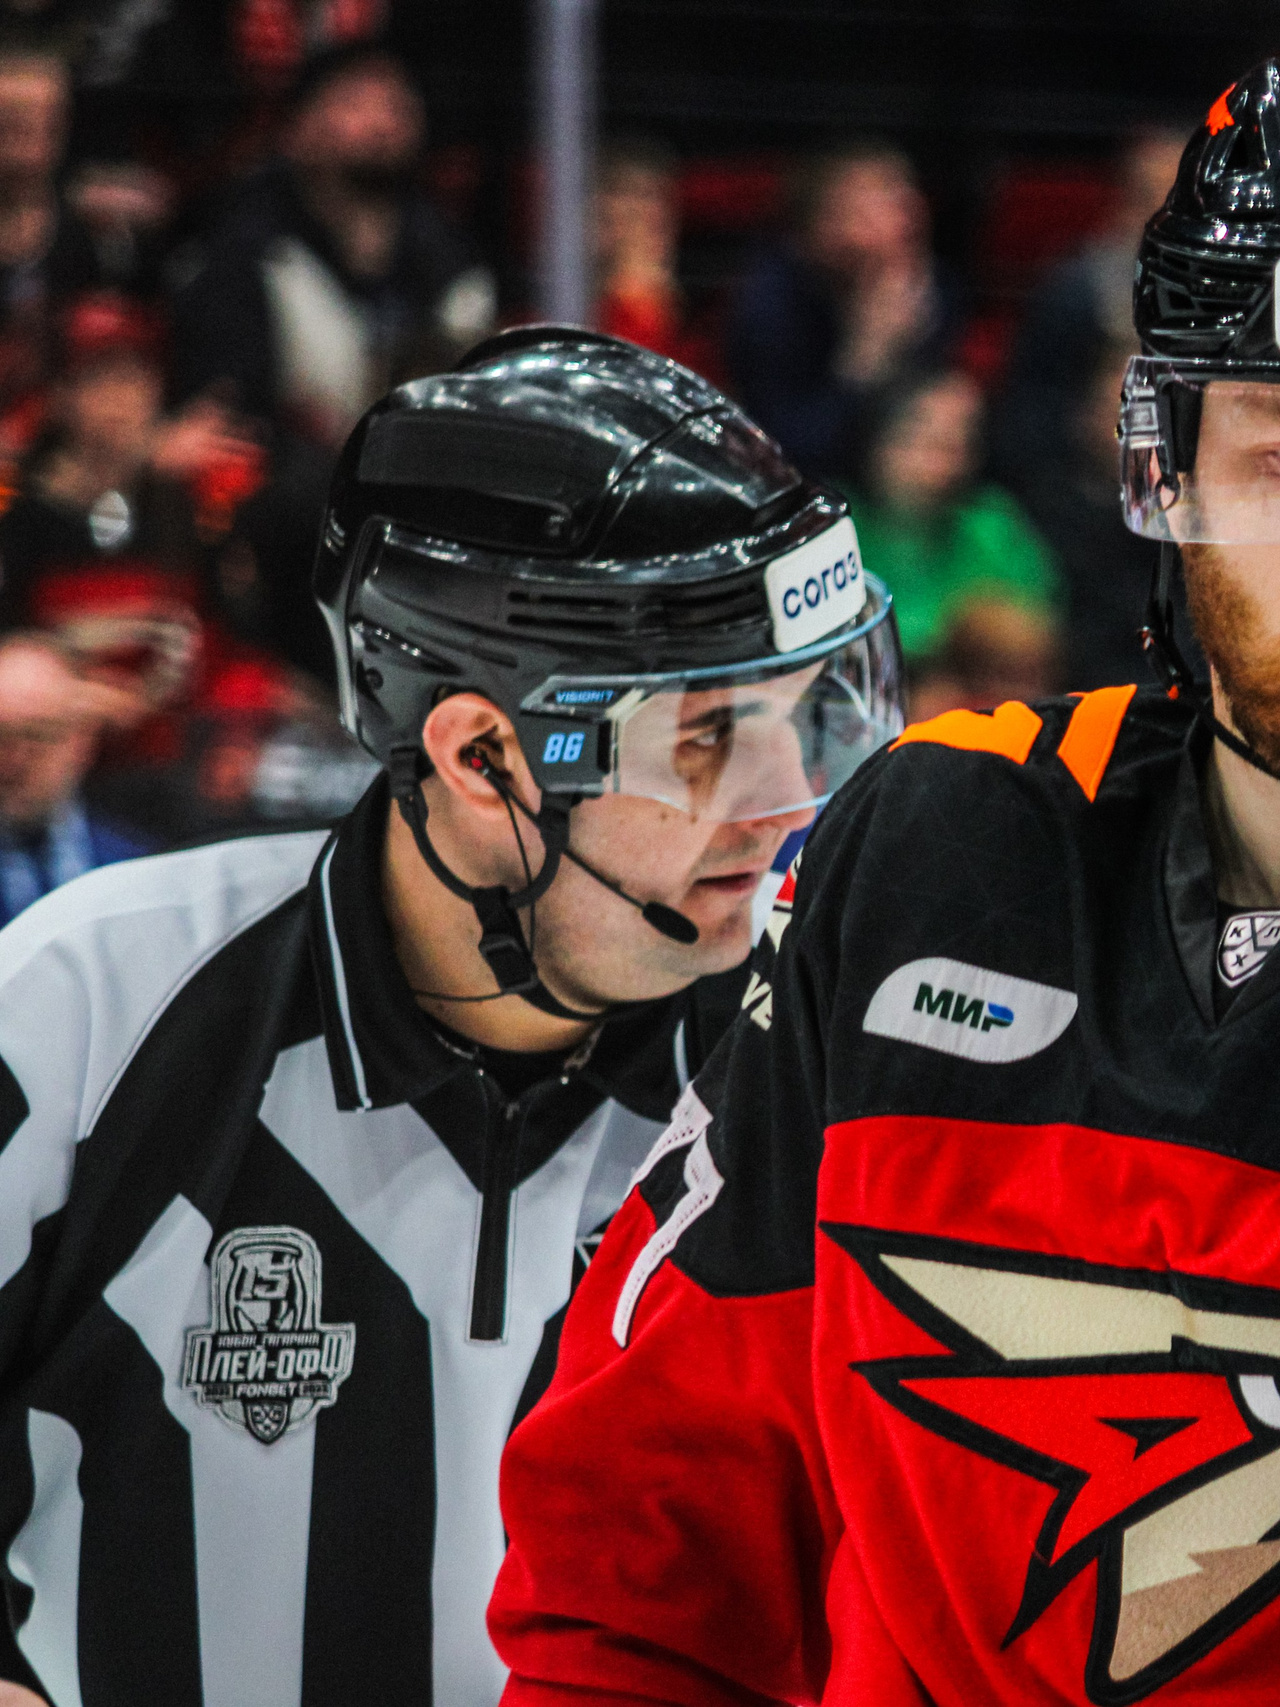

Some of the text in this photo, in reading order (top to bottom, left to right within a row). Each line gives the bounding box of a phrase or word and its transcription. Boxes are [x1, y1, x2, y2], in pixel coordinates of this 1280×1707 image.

[783, 551, 859, 619] согаз
[543, 732, 585, 764] 86
[913, 981, 1015, 1032] МИР
